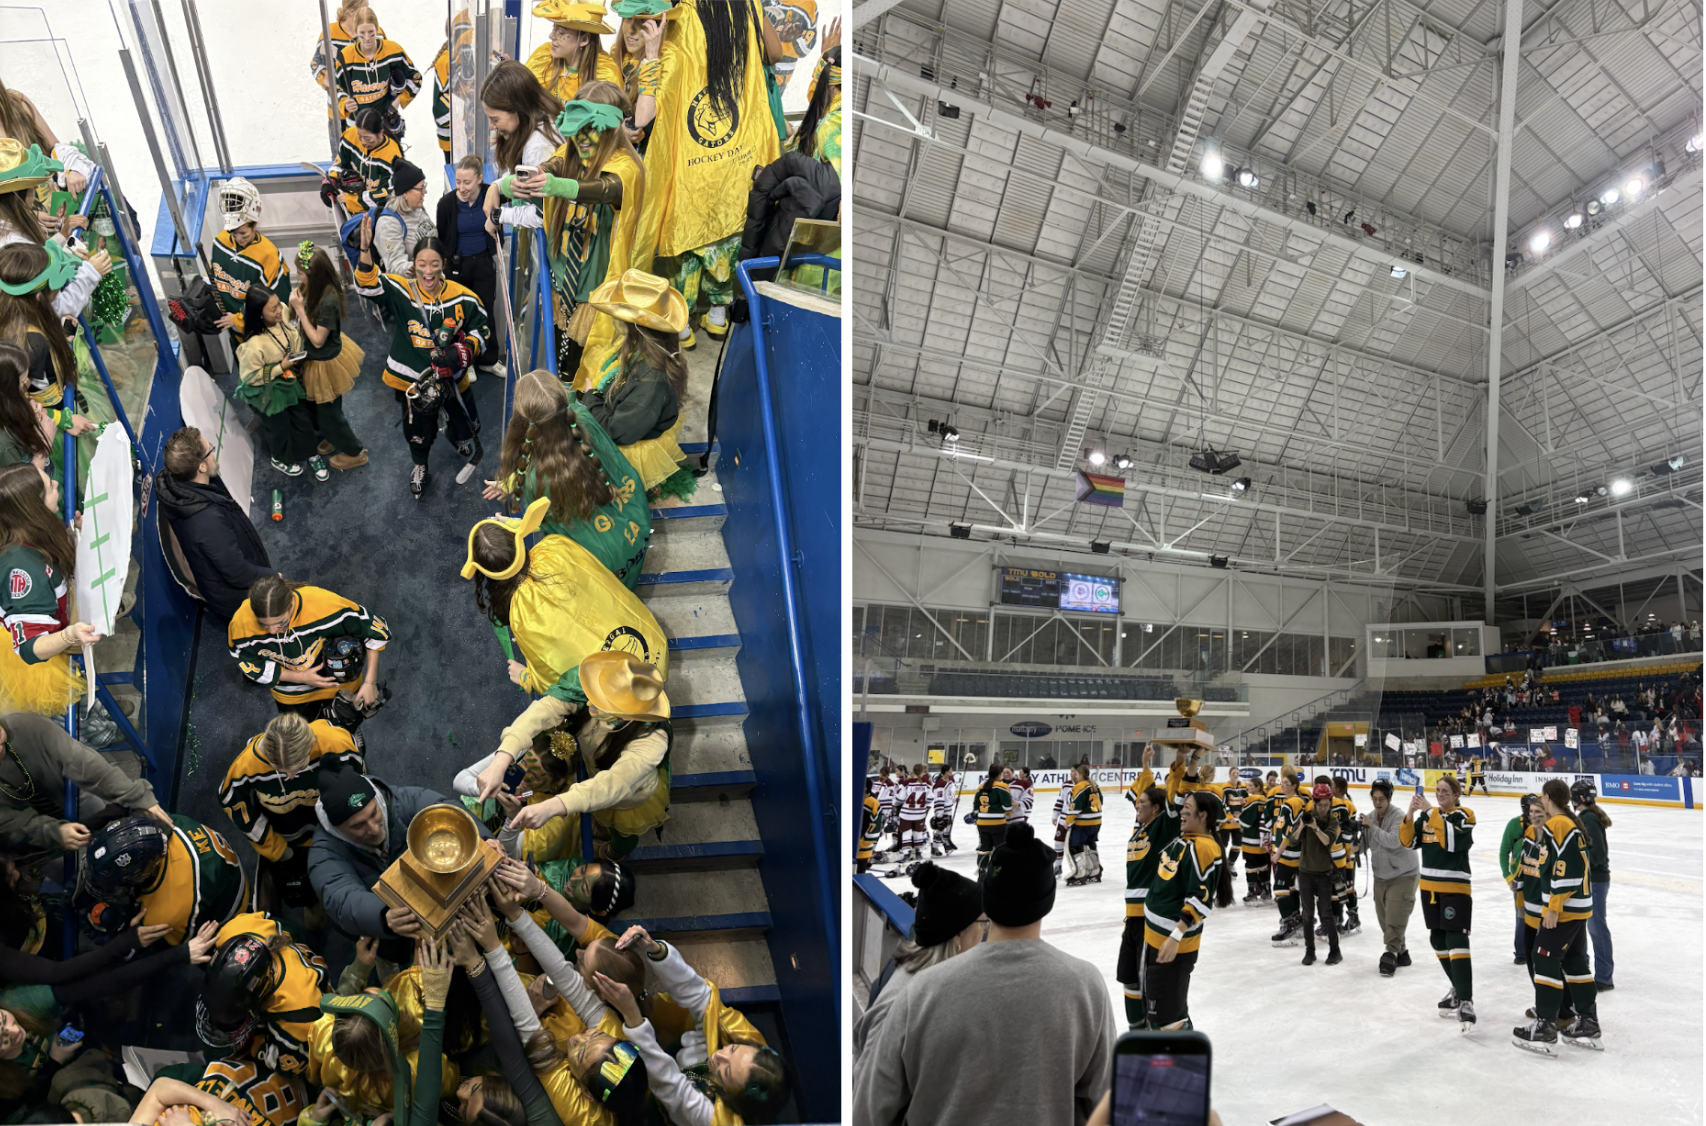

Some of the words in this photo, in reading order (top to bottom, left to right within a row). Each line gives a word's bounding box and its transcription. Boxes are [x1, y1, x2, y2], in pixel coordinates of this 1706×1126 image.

[698, 130, 734, 148] GATORS
[687, 152, 725, 167] HOCKEY
[727, 143, 745, 158] DAY
[455, 304, 465, 321] A
[1008, 568, 1028, 577] TMU
[1055, 725, 1081, 733] HOME
[1082, 725, 1096, 733] ICE
[1329, 768, 1366, 783] TMU
[1488, 772, 1512, 785] Holiday
[1512, 773, 1523, 783] Inn
[1605, 781, 1620, 789] BMO
[904, 791, 926, 808] 44
